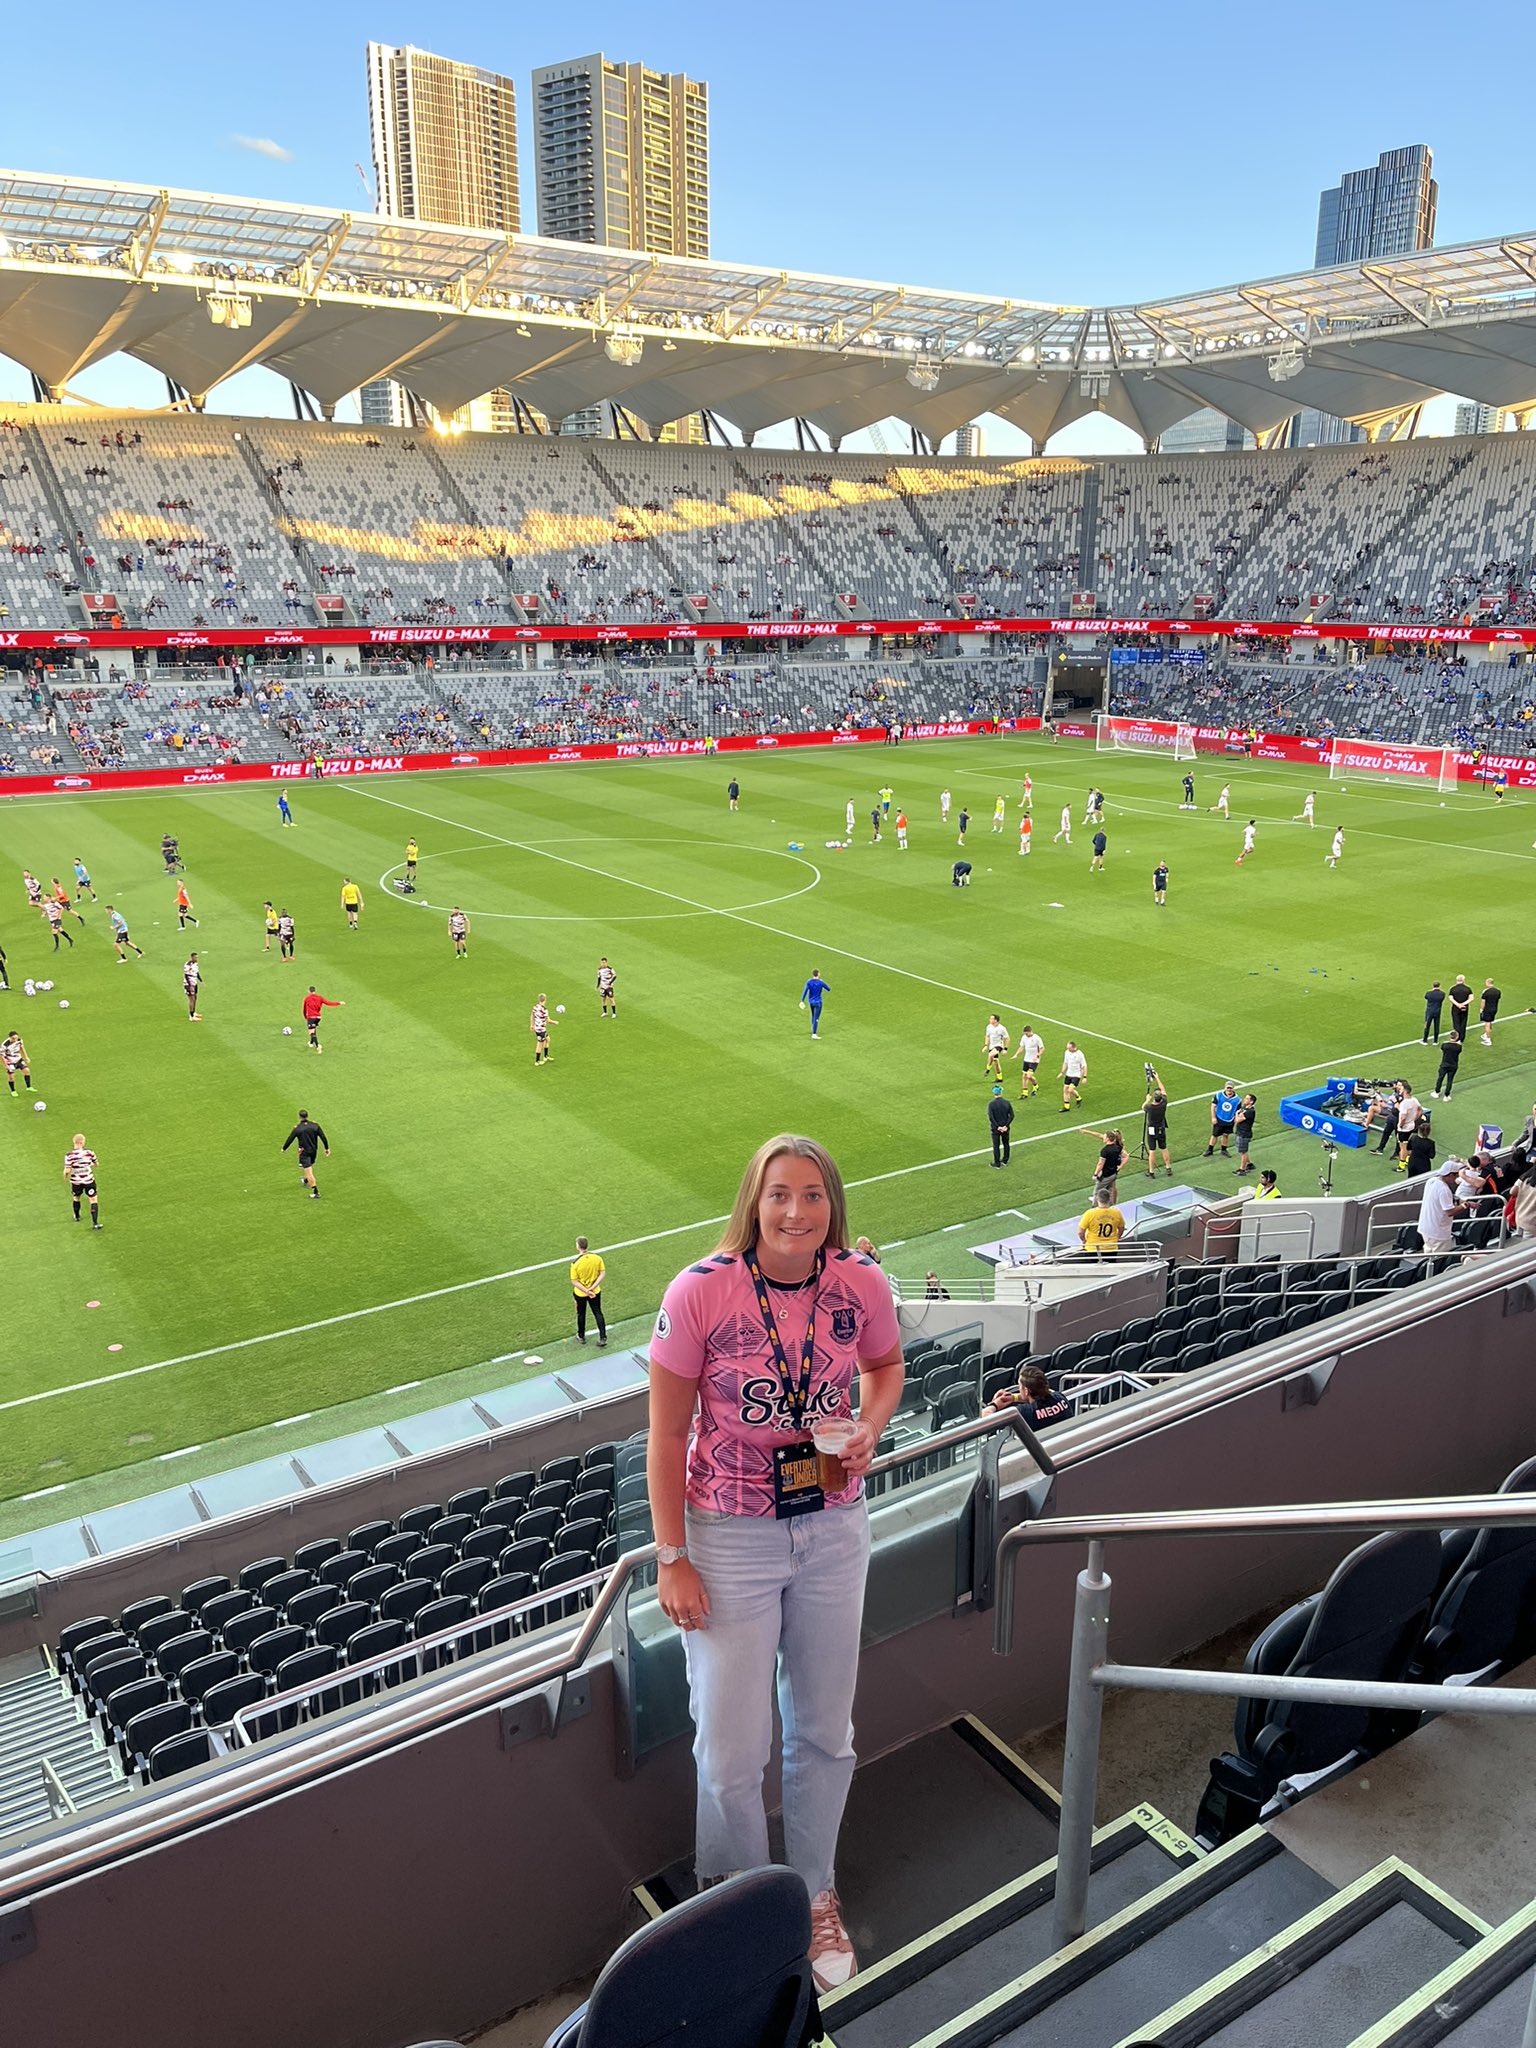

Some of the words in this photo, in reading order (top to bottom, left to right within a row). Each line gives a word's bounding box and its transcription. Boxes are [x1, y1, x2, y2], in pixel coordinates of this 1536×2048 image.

[747, 625, 768, 635] THE
[769, 625, 802, 635] ISUZU
[803, 624, 838, 634] D-MAX
[1050, 621, 1073, 630] THE
[1074, 621, 1110, 631] ISUZU
[1110, 621, 1150, 631] D-MAX
[264, 635, 304, 643] D-MAX
[370, 630, 398, 641] THE
[401, 629, 443, 641] ISUZU
[445, 628, 491, 639] D-MAX
[1367, 627, 1391, 638] THE
[1391, 628, 1429, 639] ISUZU
[1429, 629, 1473, 640] D-MAX
[166, 636, 209, 645] D-MAX
[937, 723, 970, 734] D-MAX
[1179, 727, 1198, 737] THE
[1128, 731, 1157, 744] ISUZU
[548, 752, 582, 760] D-MAX
[1257, 749, 1287, 759] D-MAX
[271, 763, 302, 776] THE
[353, 757, 404, 772] D-MAX
[1318, 751, 1342, 764] THE
[1343, 755, 1384, 769] ISUZU
[1383, 759, 1429, 775] D-MAX
[183, 772, 226, 783] D-MAX
[1097, 1223, 1113, 1238] 10
[1035, 1399, 1069, 1420] MEDIC
[781, 1458, 812, 1476] EVERTON
[793, 1469, 817, 1484] UNDER
[1137, 1808, 1154, 1822] 3
[1162, 1829, 1171, 1839] 7
[1174, 1840, 1188, 1851] 10
